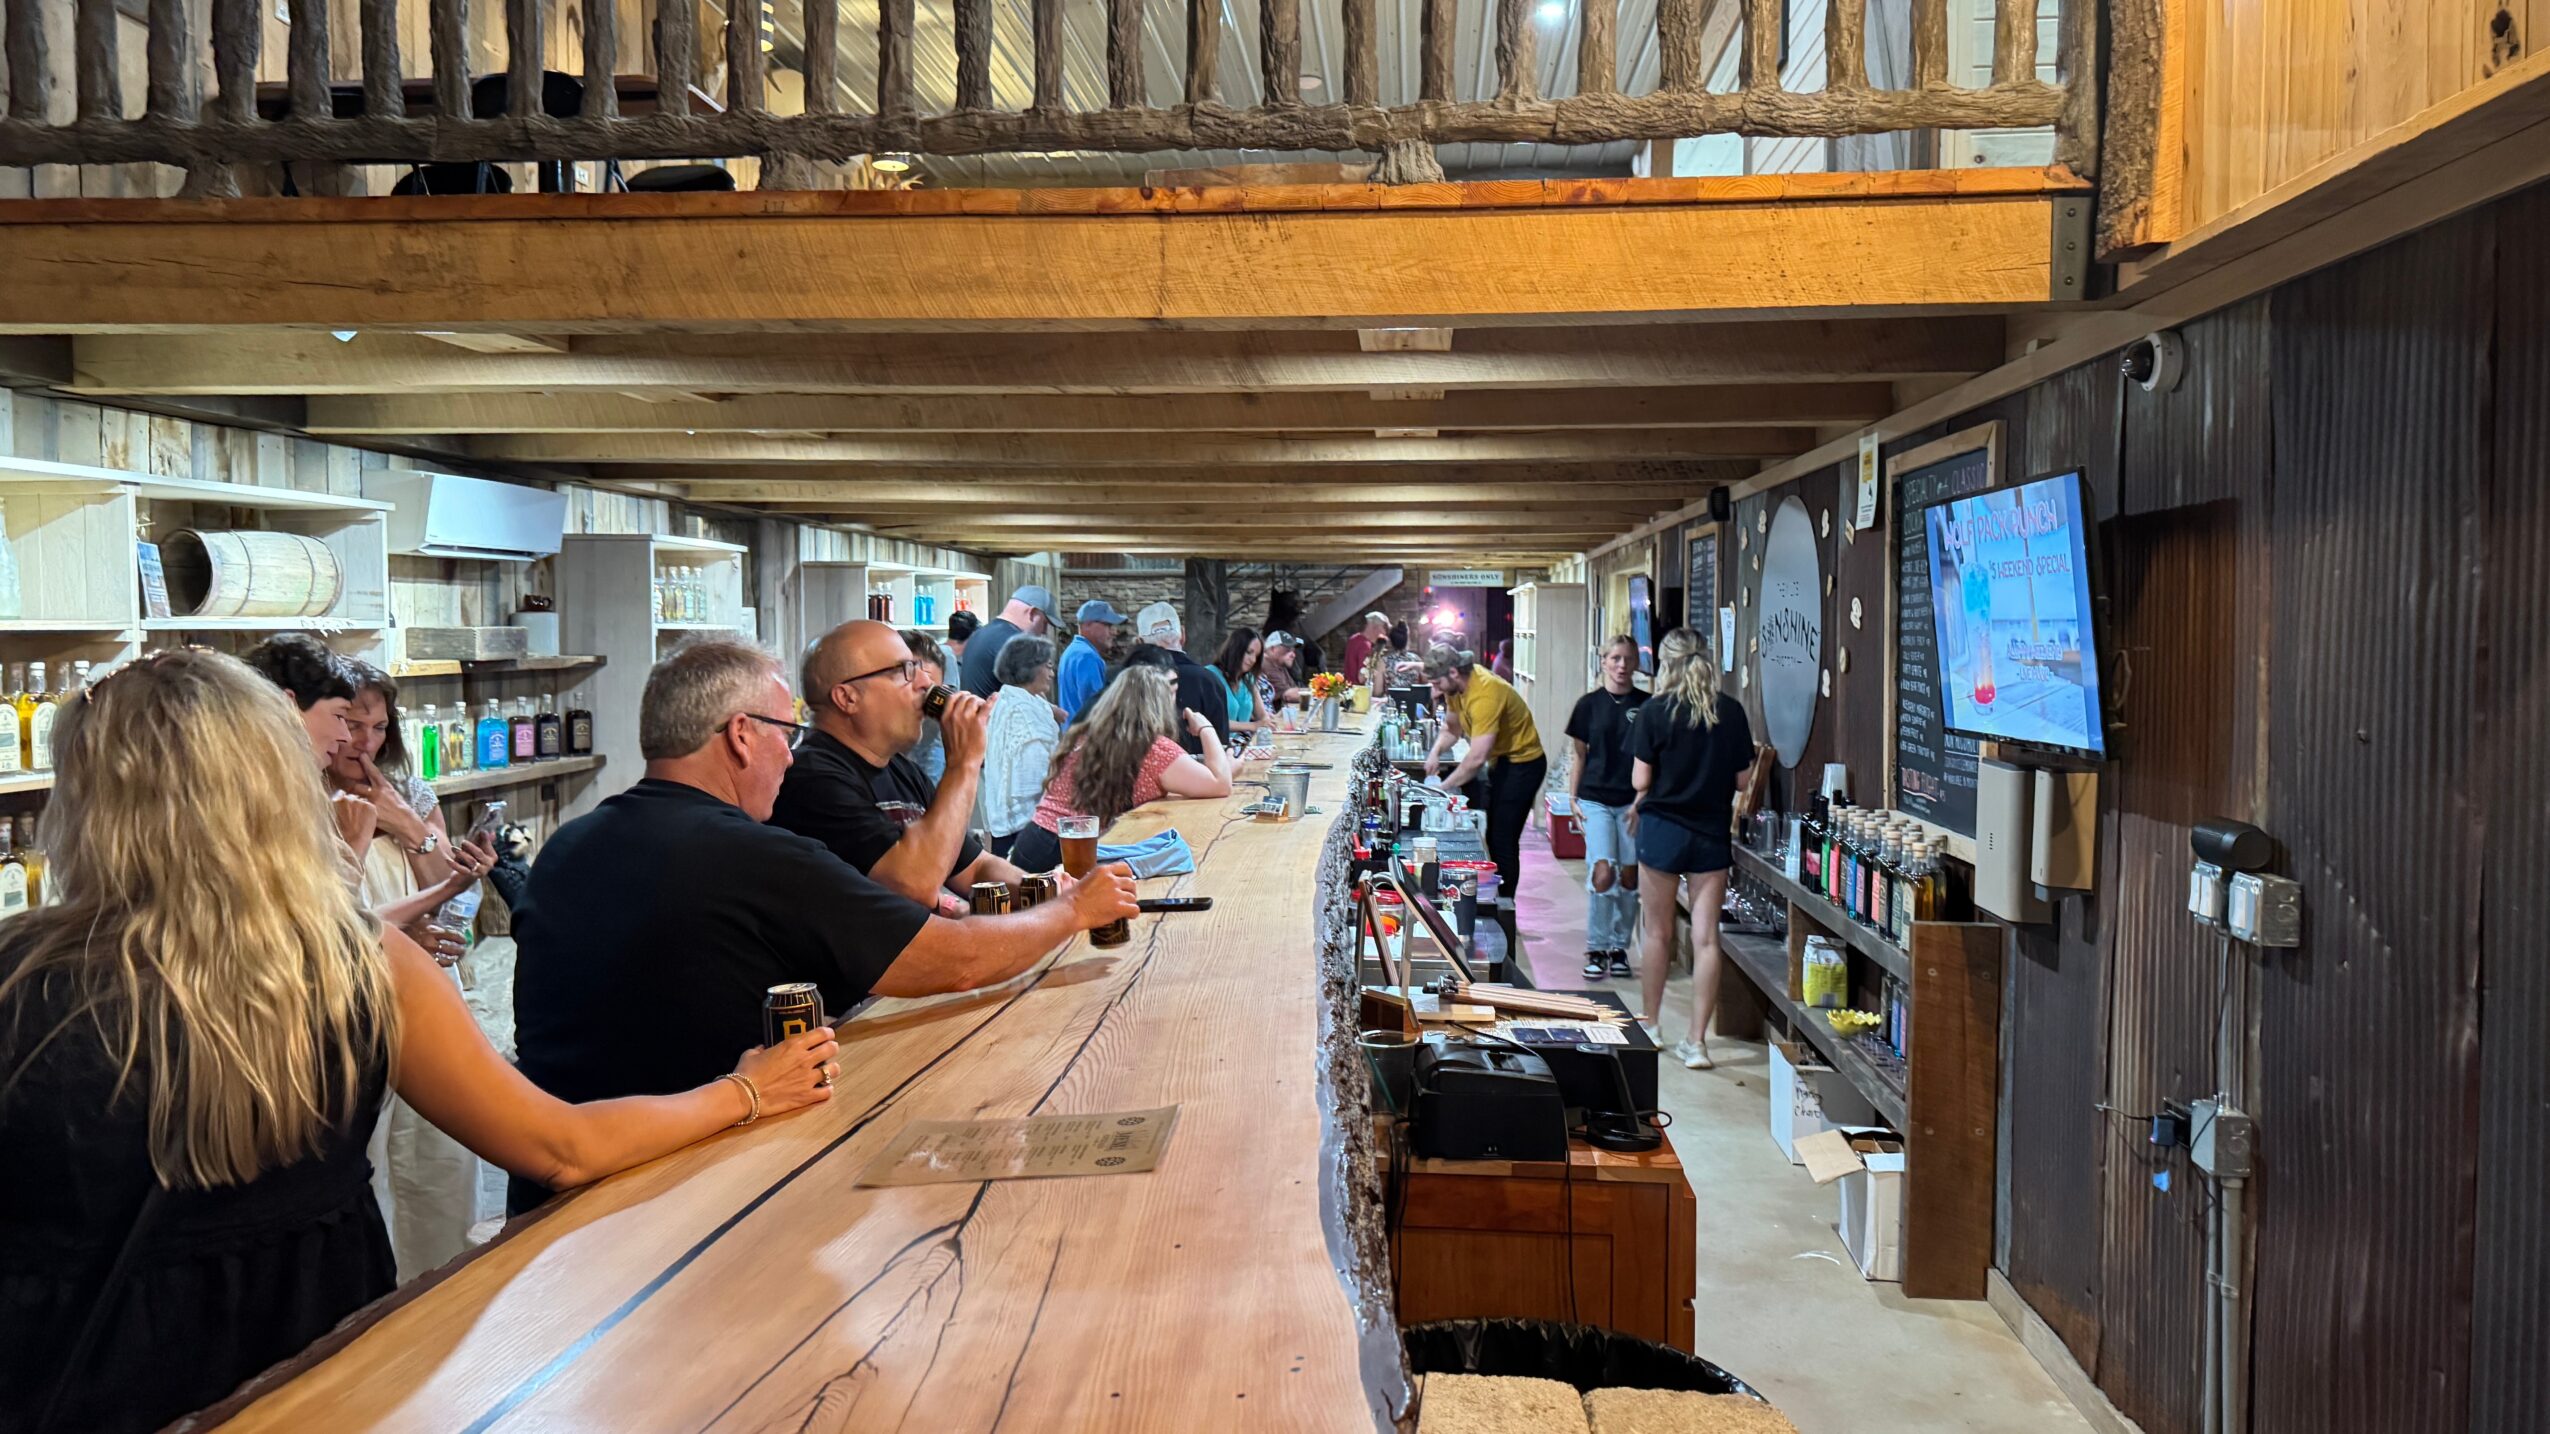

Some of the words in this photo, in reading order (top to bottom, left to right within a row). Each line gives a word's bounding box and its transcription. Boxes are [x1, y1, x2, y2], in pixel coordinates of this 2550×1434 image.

[1944, 519, 1974, 551] WOLF
[1977, 510, 2009, 544] PACK
[2009, 498, 2058, 539] PUNCH
[1998, 558, 2034, 578] WEEKEND
[2036, 553, 2070, 576] SPECIAL
